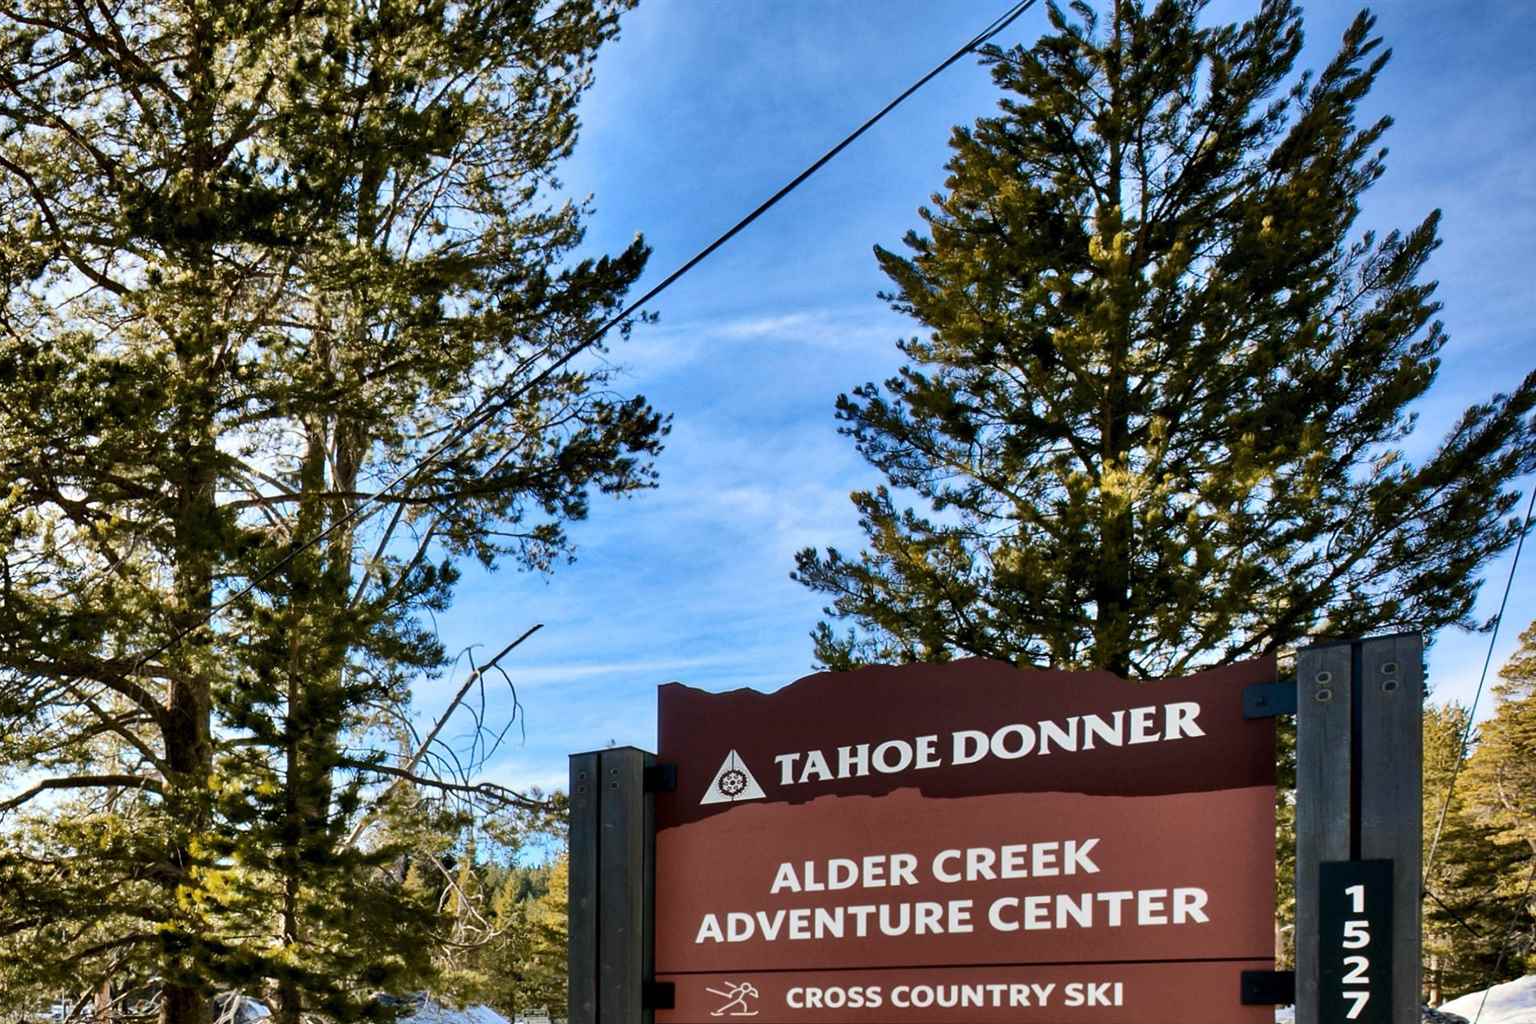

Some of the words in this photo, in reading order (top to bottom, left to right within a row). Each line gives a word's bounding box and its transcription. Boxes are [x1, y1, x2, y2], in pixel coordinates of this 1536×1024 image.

[774, 729, 943, 786] TAHOE
[950, 699, 1207, 767] DONNER
[769, 852, 920, 895] ALDER
[931, 837, 1101, 884] CREEK
[694, 898, 975, 945] ADVENTURE
[987, 886, 1211, 934] CENTER
[785, 985, 883, 1010] CROSS
[890, 983, 1057, 1009] COUNTRY
[1064, 982, 1124, 1008] SKI
